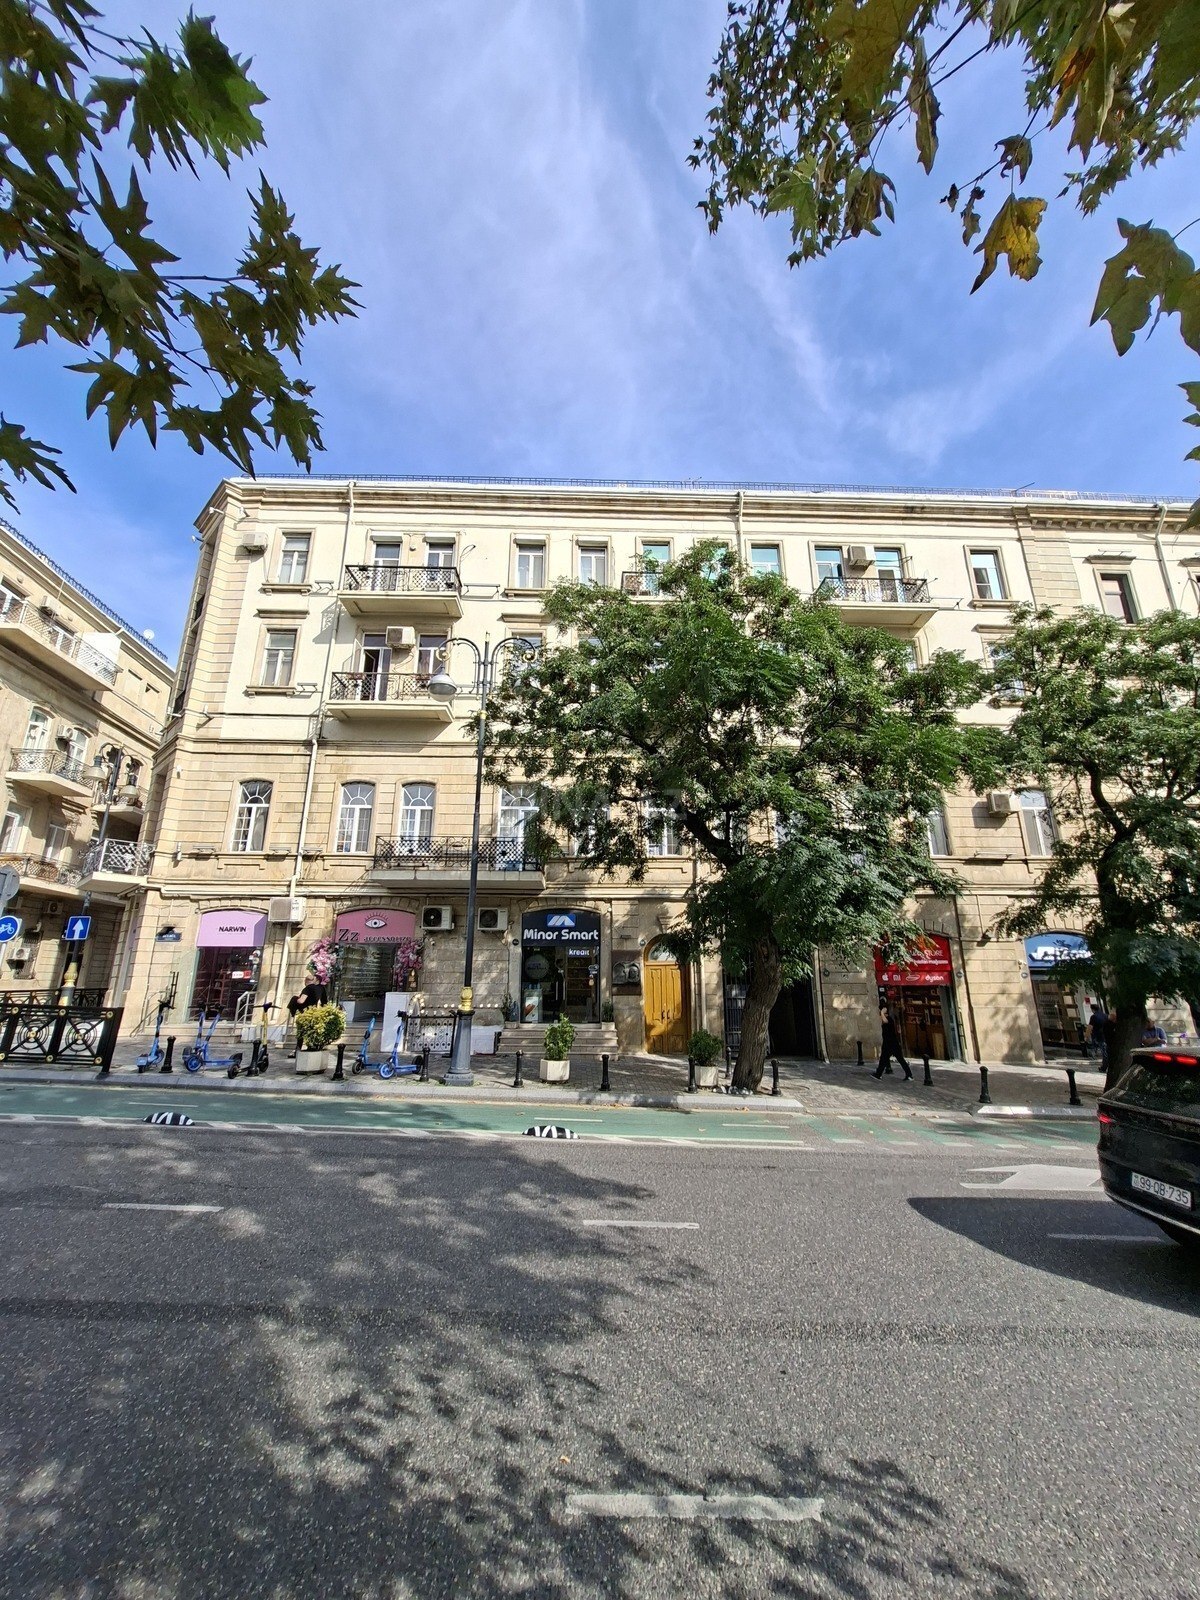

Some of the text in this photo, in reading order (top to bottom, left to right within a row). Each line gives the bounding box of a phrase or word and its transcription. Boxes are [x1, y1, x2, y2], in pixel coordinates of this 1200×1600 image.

[338, 928, 359, 942] Zz
[523, 928, 599, 940] Minor Smart
[924, 974, 944, 983] dyson
